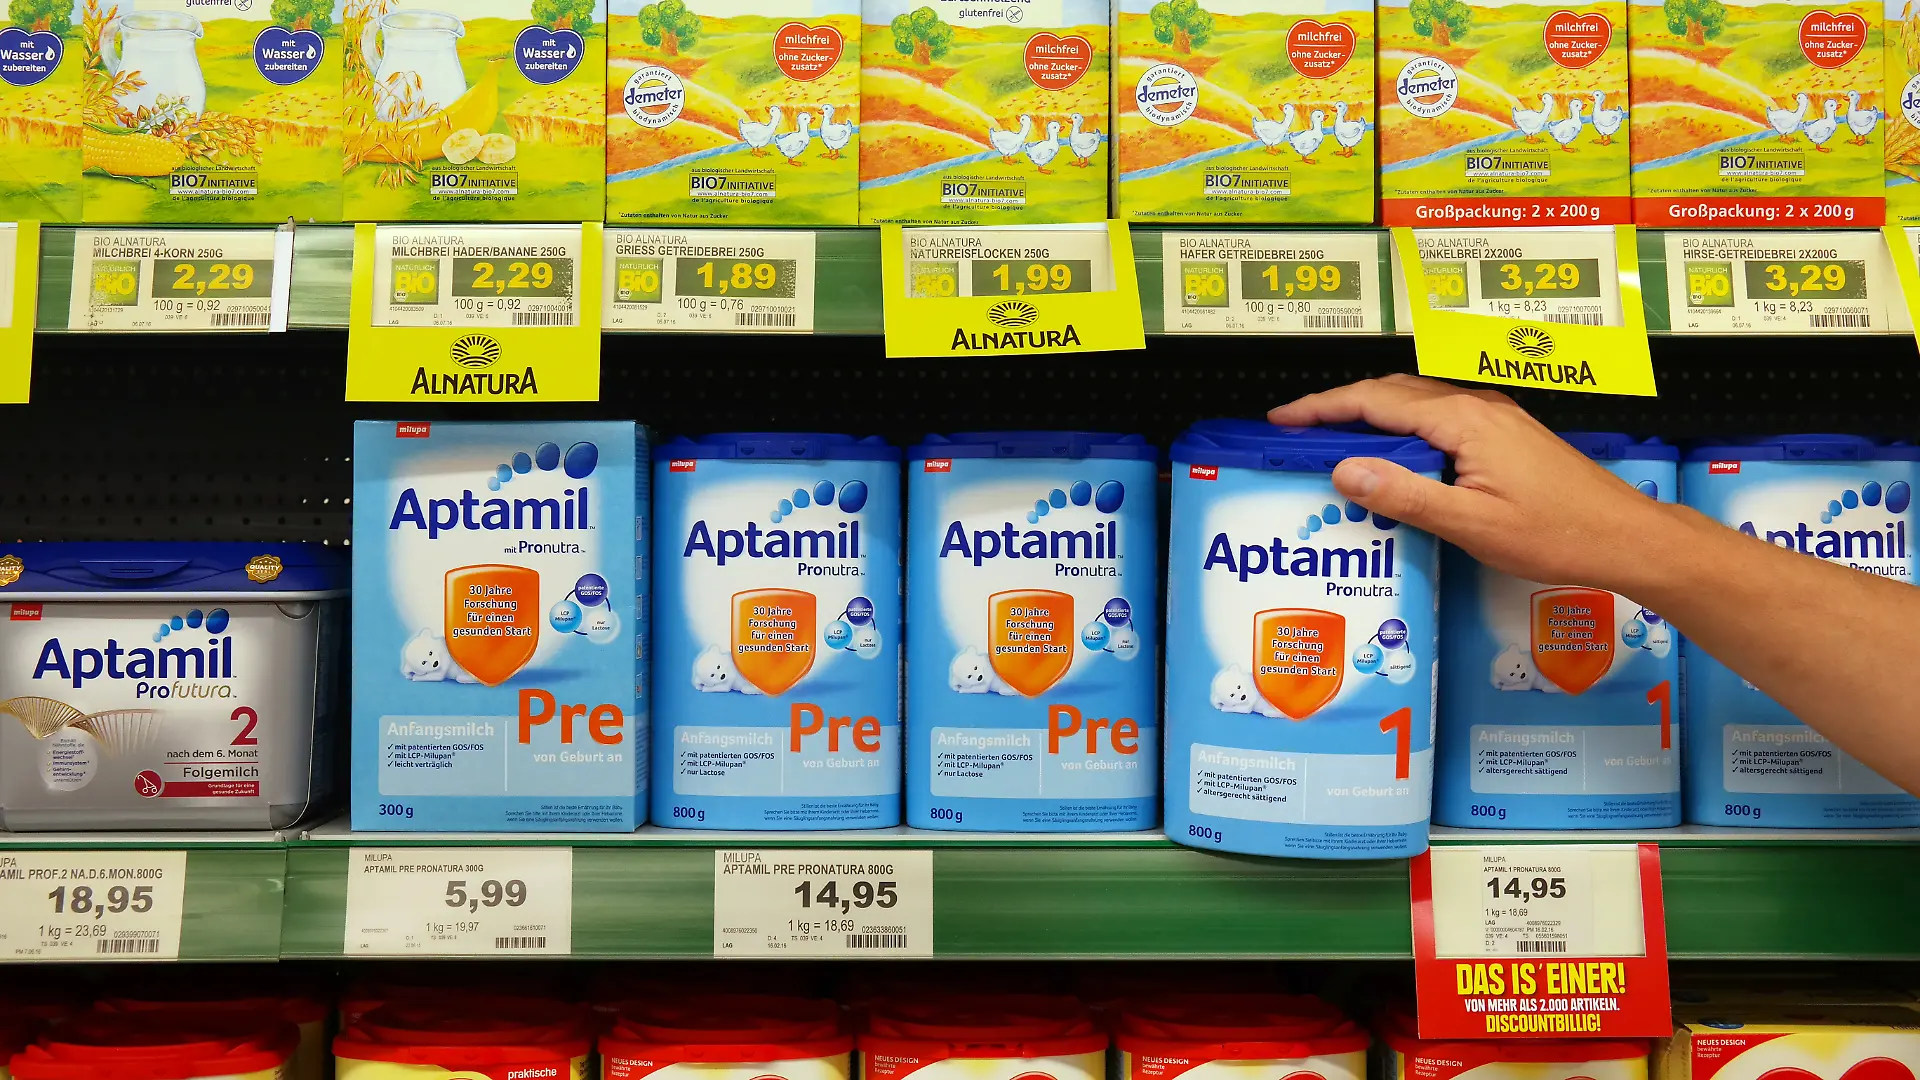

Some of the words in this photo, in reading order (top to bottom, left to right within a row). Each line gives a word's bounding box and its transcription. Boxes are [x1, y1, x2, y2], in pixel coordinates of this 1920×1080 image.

[959, 9, 1003, 19] glutenfrei
[1811, 22, 1854, 32] milchfrei
[282, 39, 295, 47] mit
[785, 35, 830, 45] milchfrei
[1805, 41, 1825, 49] ohne
[1827, 41, 1858, 49] Zucker-
[262, 48, 305, 60] Wasser
[523, 48, 565, 59] Wasser
[779, 53, 799, 61] ohne
[801, 53, 832, 62] Zucker-
[265, 63, 308, 71] zubereiten
[525, 62, 568, 71] zubereiten
[1398, 79, 1456, 95] demeter
[625, 88, 682, 105] demeter
[1416, 206, 1526, 221] Großpackung:
[1532, 205, 1540, 217] 2
[1546, 208, 1554, 217] x
[1560, 205, 1586, 218] 200
[1590, 209, 1600, 220] g
[93, 237, 111, 246] BIO
[113, 237, 166, 247] ALNATURA
[616, 235, 633, 244] BIO
[635, 235, 688, 244] ALNATURA
[911, 238, 927, 247] BIO
[930, 238, 982, 247] ALNATURA
[1180, 239, 1197, 247] BIO
[1199, 239, 1250, 248] ALNATURA
[93, 248, 151, 258] MILCHBREI
[154, 249, 195, 258] 4-KORN
[198, 249, 223, 258] 250G
[392, 247, 450, 256] MILCHBREI
[453, 247, 538, 256] HADER/BANANE
[540, 247, 566, 256] 250G
[616, 245, 655, 255] GRIESS
[658, 246, 736, 256] GETREIDEBREI
[739, 248, 764, 257] 250G
[910, 249, 1021, 259] NATURREISFLOCKEN
[1024, 249, 1049, 258] 250G
[1180, 250, 1216, 259] HAFER
[1218, 250, 1296, 259] GETREIDEBREI
[1299, 250, 1324, 260] 250G
[1484, 249, 1523, 258] 2X200G
[1684, 249, 1796, 259] HIRSE-GETREIDEBREI
[1799, 249, 1837, 259] 2X200G
[172, 264, 254, 296] 2,29
[472, 263, 553, 294] 2,29
[697, 262, 776, 294] 1,89
[992, 264, 1072, 296] 1,99
[1262, 265, 1341, 297] 1,99
[1500, 264, 1580, 296] 3,29
[1765, 265, 1846, 297] 3,29
[678, 299, 696, 309] 100
[700, 301, 706, 311] g
[720, 299, 744, 311] 0,76
[1488, 301, 1493, 311] 1
[1499, 301, 1511, 314] kg
[1524, 301, 1547, 313] 8,23
[951, 324, 1081, 350] ALNATURA
[1478, 351, 1597, 385] ALNATURA
[410, 367, 538, 394] ALNATURA
[389, 487, 588, 539] Aptamil
[683, 520, 859, 566] Aptamil
[1203, 532, 1394, 582] Aptamil
[250, 564, 280, 572] QUALITY
[753, 607, 764, 616] 30
[767, 607, 792, 616] Jahre
[748, 619, 796, 630] Forschung
[751, 631, 765, 639] für
[738, 644, 784, 654] gesunden
[786, 643, 809, 652] Start
[32, 636, 232, 689] Aptamil
[136, 681, 231, 698] Profutura
[518, 688, 624, 745] Pre
[230, 706, 258, 745] 2
[387, 722, 494, 739] Anfangsmilch
[1048, 704, 1139, 755] Pre
[1379, 706, 1412, 780] 1
[167, 750, 189, 758] nach
[192, 750, 213, 758] dem
[216, 750, 226, 758] 6.
[228, 750, 258, 758] Monat
[415, 761, 453, 769] verträglich
[1061, 761, 1081, 770] von
[1085, 760, 1123, 770] Geburt
[1126, 761, 1138, 769] an
[183, 767, 259, 779] Folgemilch
[957, 770, 983, 778] Lactose
[1217, 772, 1262, 784] patentierten
[1264, 776, 1297, 785] GOS/FOS
[1203, 788, 1250, 800] altersgerecht
[1252, 793, 1287, 803] sättigend
[379, 804, 401, 816] 300
[405, 807, 414, 818] g
[930, 808, 953, 819] 800
[955, 811, 963, 823] g
[1725, 804, 1750, 816] 800
[1753, 807, 1761, 819] g
[364, 854, 392, 862] MILUPA
[723, 853, 762, 863] MILUPA
[29, 869, 67, 880] PROF.2
[70, 869, 163, 880] NA.D.6.MON.800G
[364, 865, 397, 873] APTAMIL
[399, 865, 414, 873] PRE
[417, 865, 463, 873] PRONATURA
[465, 864, 483, 872] 300G
[724, 864, 770, 874] APTAMIL
[774, 865, 795, 874] PRE
[798, 864, 865, 874] PRONATURA
[868, 864, 893, 874] 800G
[445, 879, 527, 913] 5,99
[1487, 877, 1567, 903] 14,95
[48, 885, 153, 919] 18,95
[795, 881, 898, 915] 14,95
[789, 920, 793, 930] 1
[798, 920, 810, 934] kg
[825, 920, 854, 933] 18,69
[1456, 963, 1505, 995] DAS
[1547, 962, 1626, 994] EINER!
[1465, 999, 1485, 1012] VON
[1488, 999, 1517, 1012] MEHR
[1519, 999, 1537, 1011] ALS
[1539, 999, 1568, 1011] 2.000
[1570, 998, 1620, 1011] ARTIKELN.
[1486, 1014, 1601, 1033] DISCOUNTBILLIG!
[508, 1068, 557, 1080] praktische
